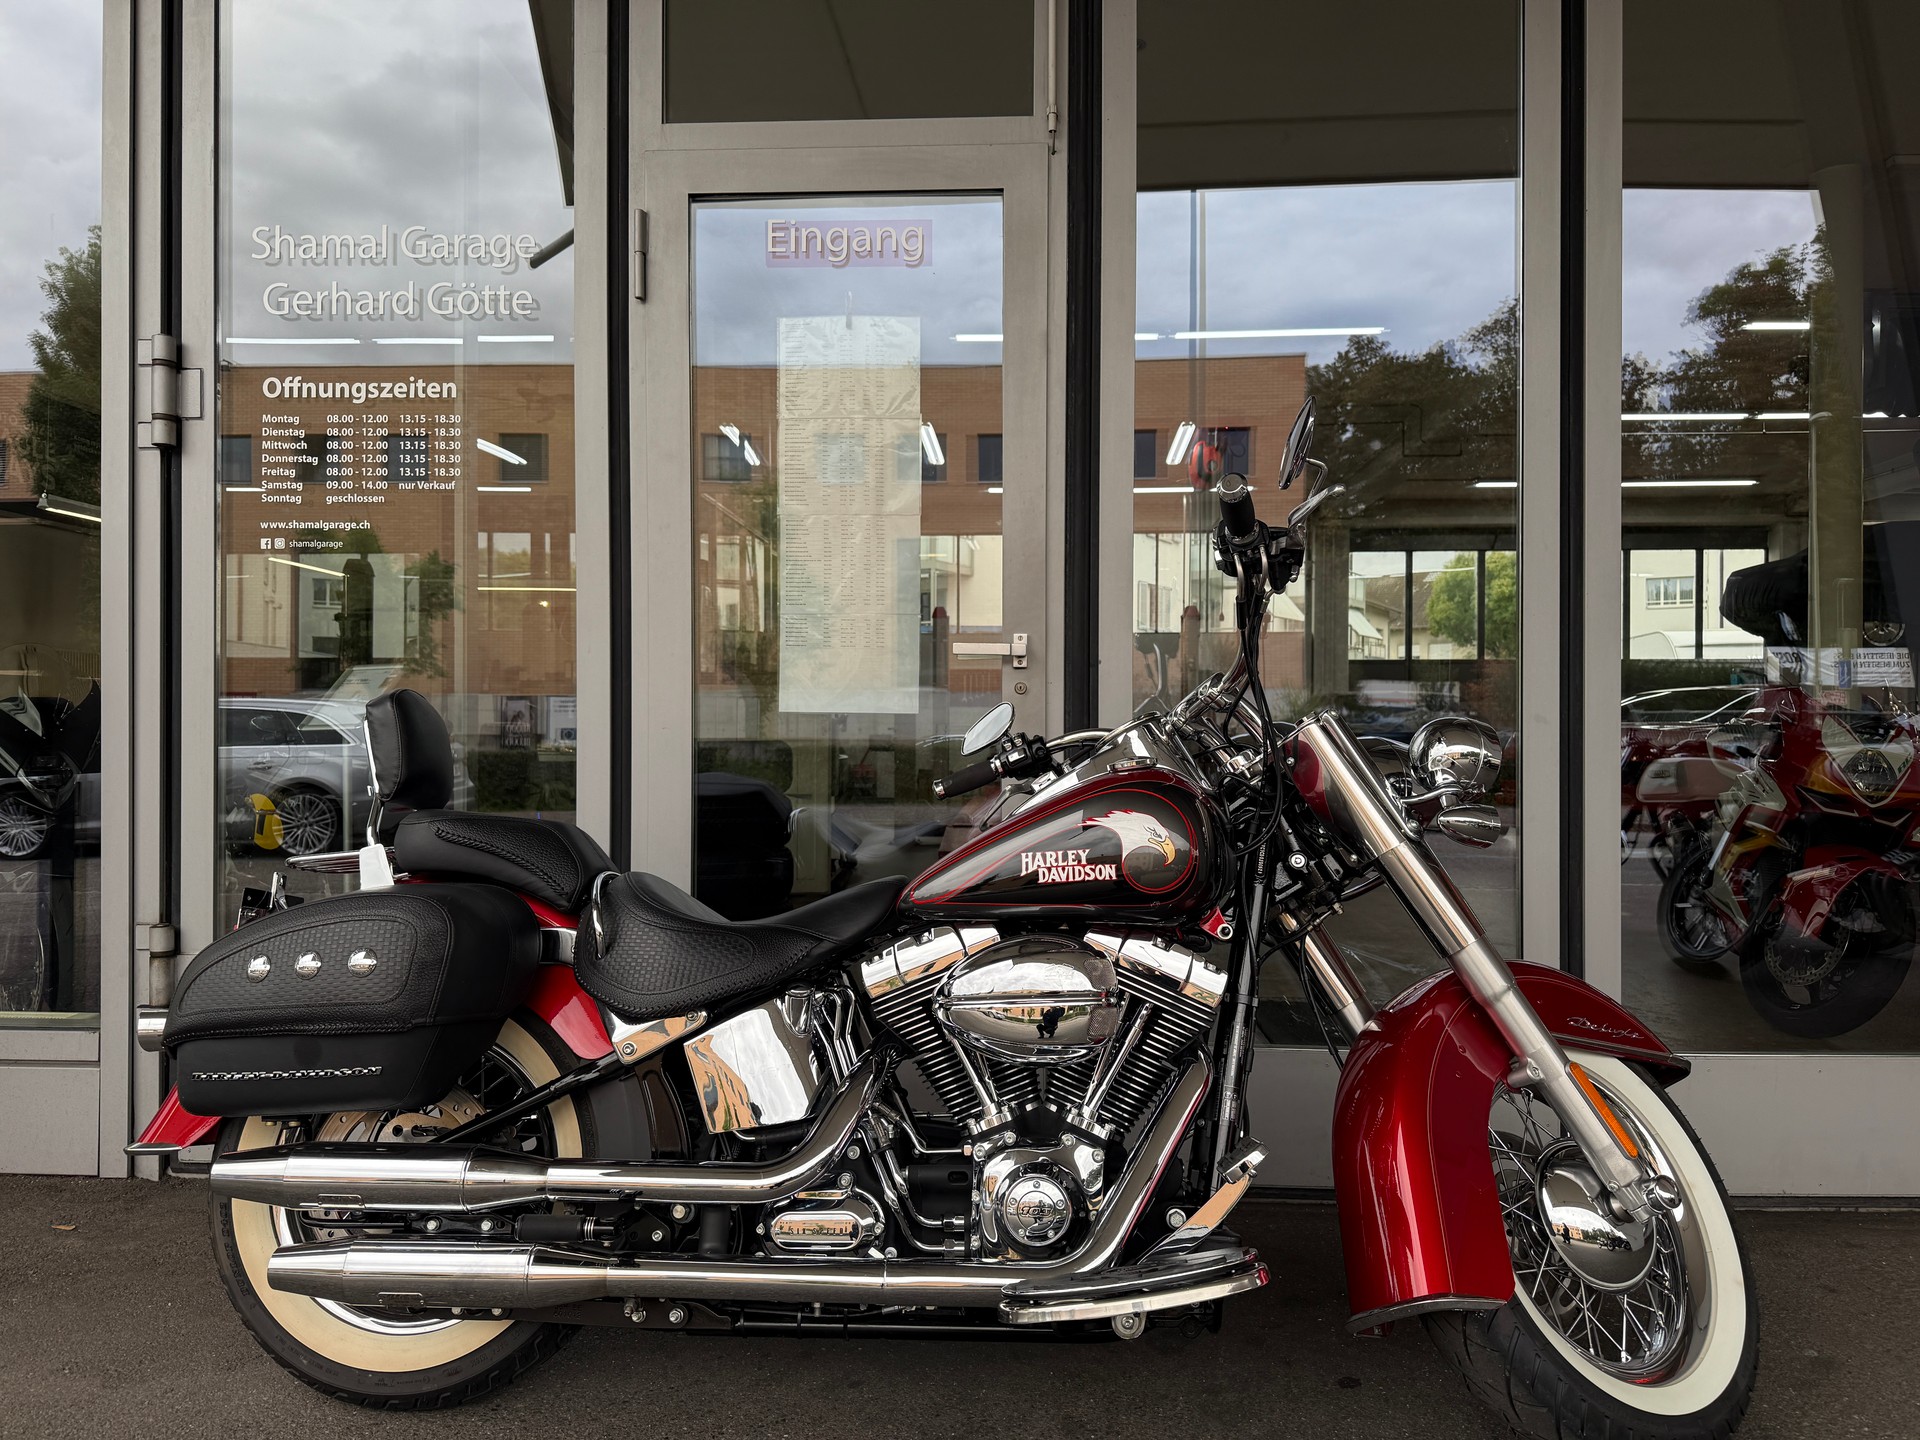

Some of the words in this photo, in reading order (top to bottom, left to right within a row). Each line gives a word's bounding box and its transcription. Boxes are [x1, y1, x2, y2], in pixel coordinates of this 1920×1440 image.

[251, 224, 389, 260] Shamal
[400, 225, 537, 268] Garage
[766, 218, 924, 262] Eingang
[262, 280, 415, 316] Gerhard
[427, 281, 534, 316] Götte
[263, 414, 300, 426] Montag
[326, 414, 354, 423] 08.00
[361, 414, 389, 423] 12.00
[399, 414, 426, 423] 13.15
[434, 414, 461, 423] 18.30
[262, 427, 305, 439] Dienstag
[326, 427, 354, 436] 08.00
[361, 427, 389, 436] 12.00
[399, 427, 426, 436] 13.15
[434, 427, 461, 436] 18.30
[262, 440, 308, 450] Mittwoch
[326, 441, 354, 450] 08.00
[361, 441, 389, 450] 12.00
[399, 441, 426, 450] 13.15
[434, 441, 461, 450] 18.30
[262, 453, 319, 466] Donnerstag
[326, 454, 354, 463] 08.00
[361, 454, 389, 463] 12.00
[399, 454, 426, 463] 13.15
[434, 454, 461, 463] 18.30
[261, 466, 296, 478] Freitag
[326, 467, 354, 476] 08.00
[361, 467, 389, 476] 12.00
[399, 467, 426, 476] 13.15
[434, 467, 461, 476] 18.30
[261, 480, 303, 492] Samstag
[326, 480, 354, 489] 09.00
[361, 480, 389, 489] 14.00
[399, 482, 416, 490] nur
[417, 480, 456, 490] Verkauf
[261, 493, 302, 505] Sonntag
[326, 493, 385, 505] geschlossen
[260, 519, 371, 531] www.shamalgarage.ch
[289, 539, 344, 550] shamalgarage
[1020, 848, 1091, 877] HARLEY
[1037, 863, 1118, 884] DAVIDSON
[1566, 1016, 1645, 1039] Deluxe
[191, 1065, 383, 1082] HARLEY-DAVIDSON
